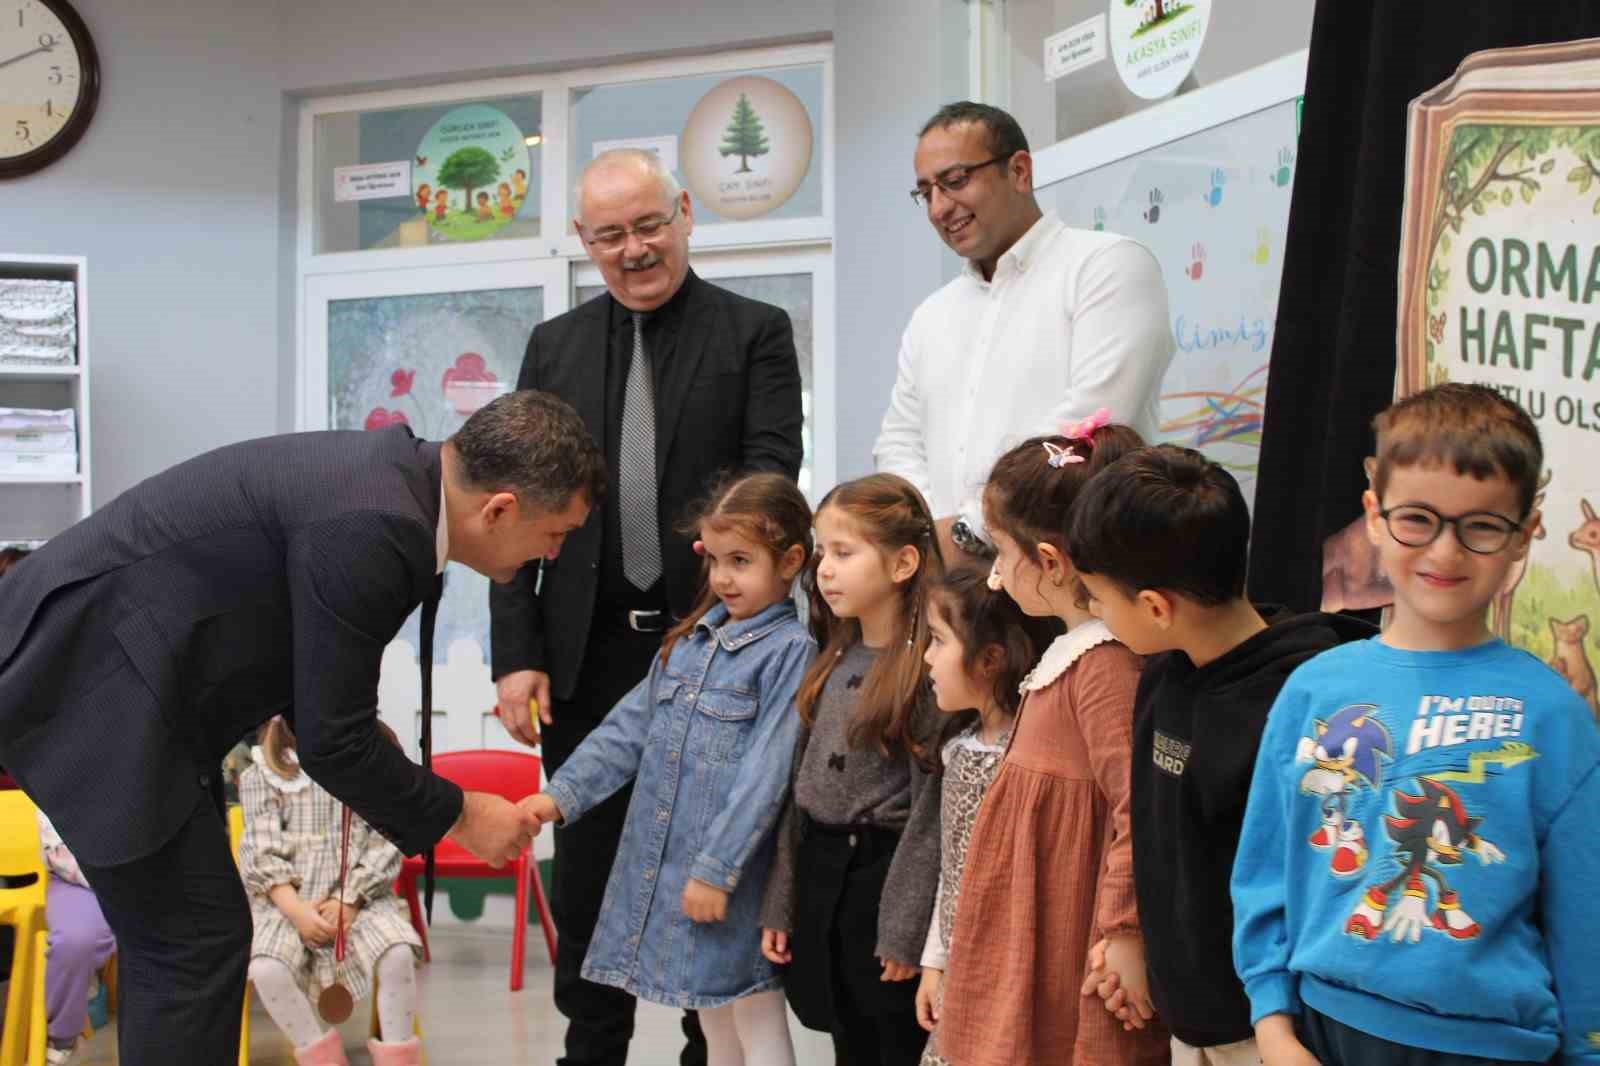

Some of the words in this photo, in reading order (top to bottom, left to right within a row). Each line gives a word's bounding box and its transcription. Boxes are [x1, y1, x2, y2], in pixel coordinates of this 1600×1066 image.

[18, 9, 24, 28] 1
[48, 66, 63, 85] 3
[16, 120, 30, 140] 5
[1417, 695, 1466, 717] I'M
[1406, 711, 1524, 755] HERE!
